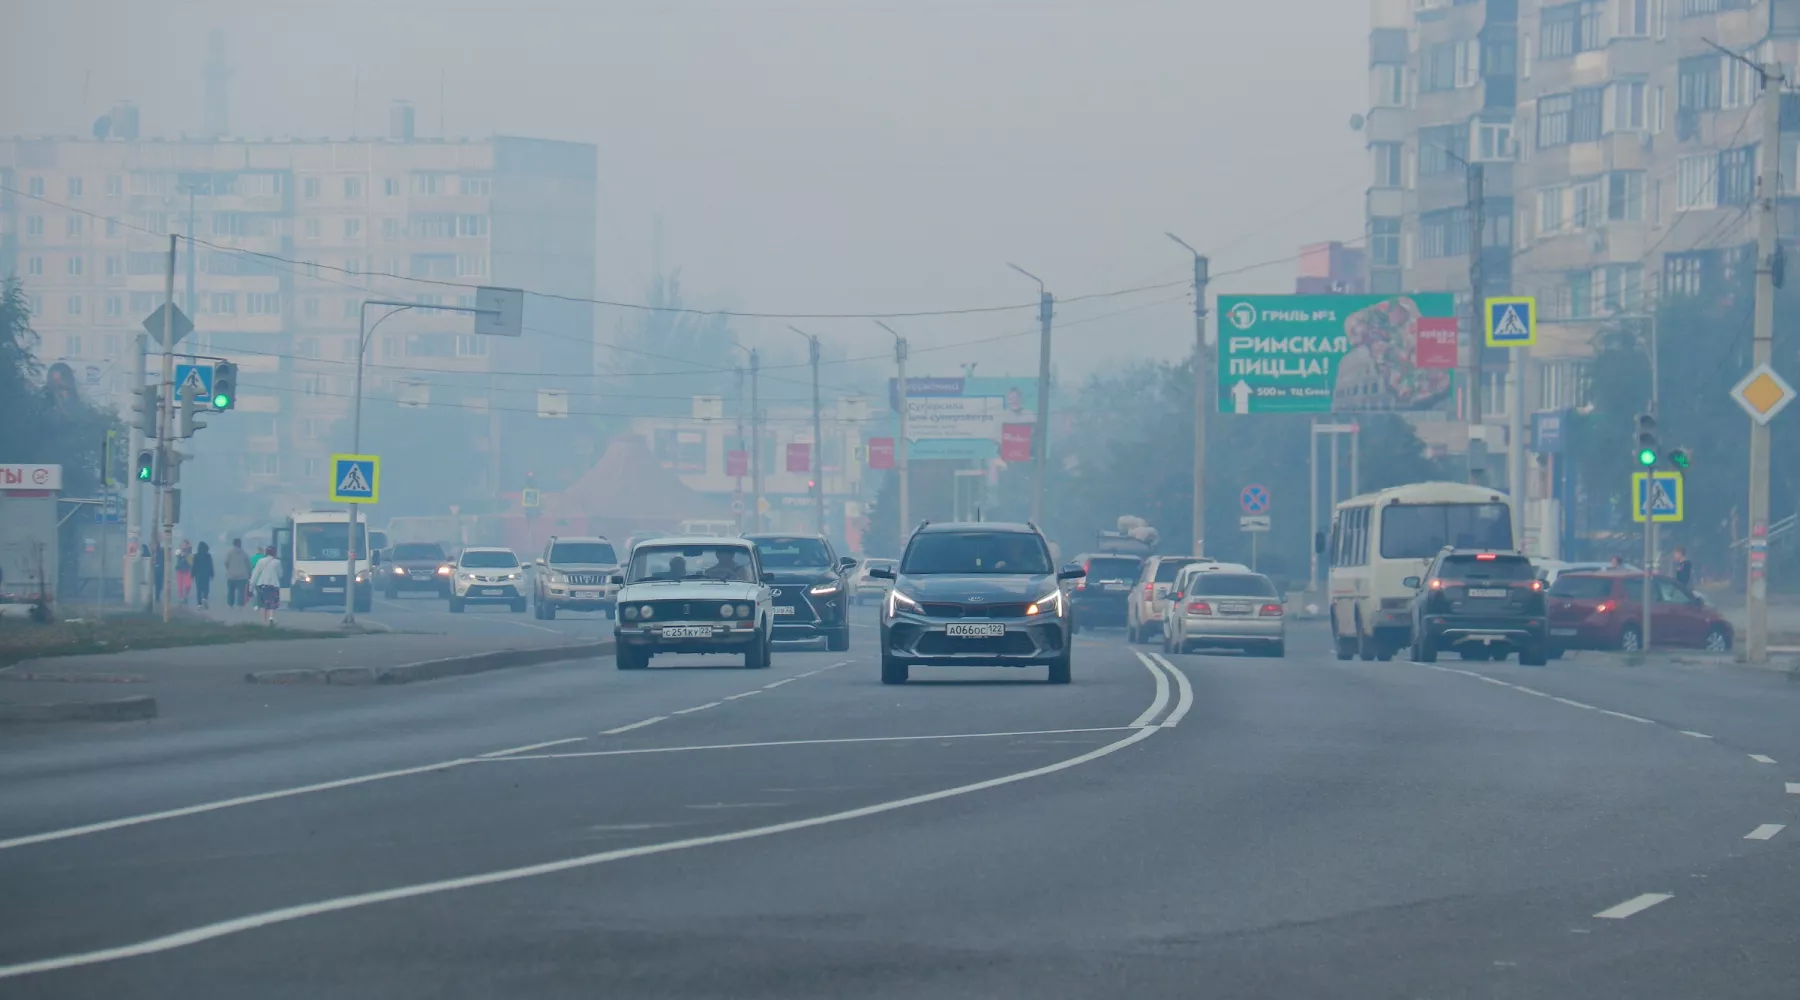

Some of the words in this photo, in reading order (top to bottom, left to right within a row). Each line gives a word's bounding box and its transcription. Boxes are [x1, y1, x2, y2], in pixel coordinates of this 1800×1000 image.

[1262, 310, 1308, 322] ГРИЛЬ
[1312, 310, 1336, 322] №1
[1229, 336, 1348, 354] РИМСКАЯ
[1230, 357, 1329, 379] ПИЦЦА!
[1257, 387, 1276, 396] 500
[665, 628, 699, 637] С251КУ
[700, 627, 709, 635] 22
[949, 625, 987, 635] А066ОС
[988, 624, 1003, 633] 122
